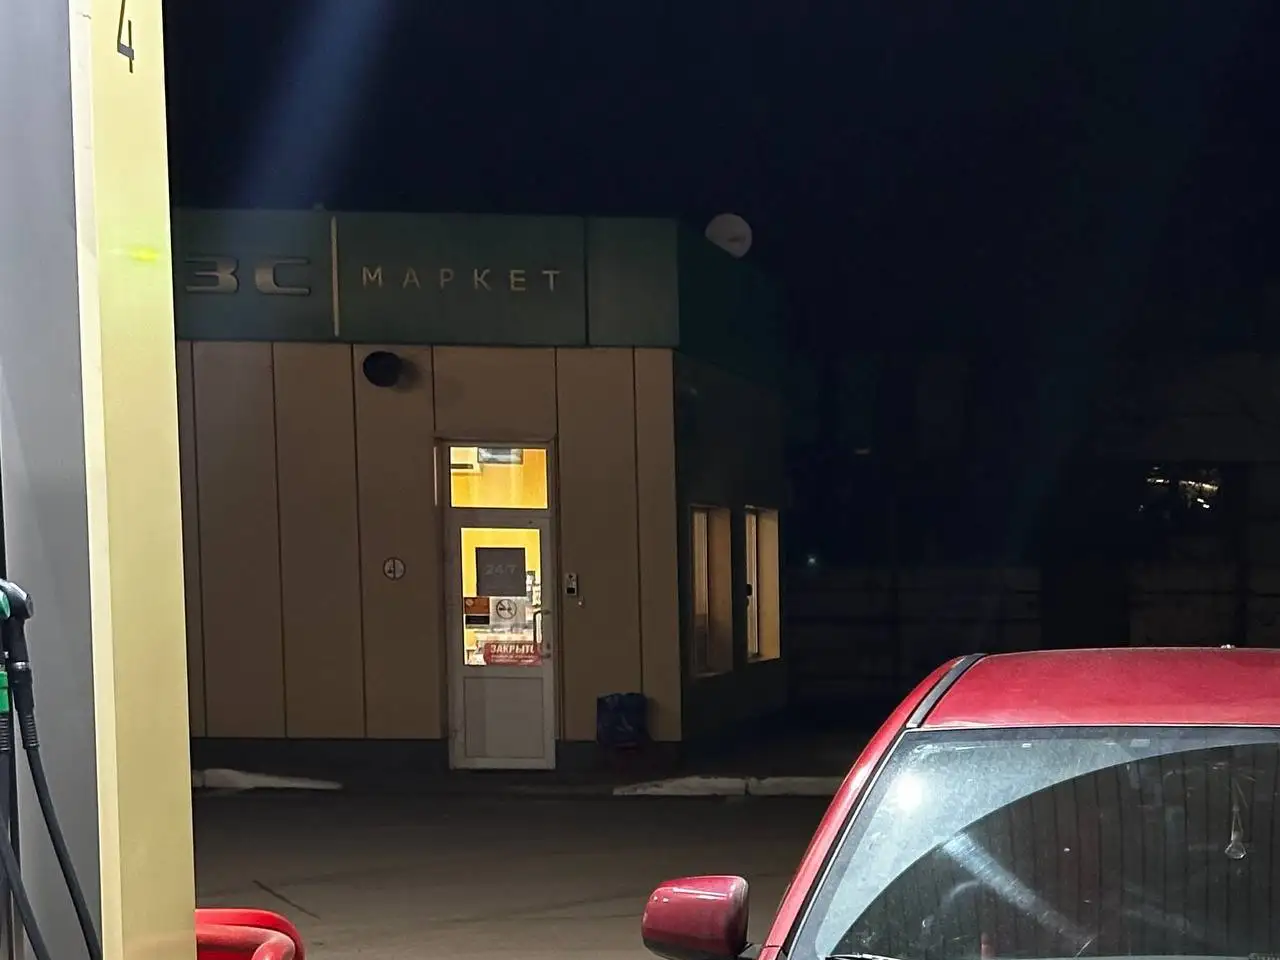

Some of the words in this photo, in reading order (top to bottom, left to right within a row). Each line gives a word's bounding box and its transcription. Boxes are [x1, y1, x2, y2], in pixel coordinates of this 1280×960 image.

[117, 0, 135, 74] 4
[185, 254, 311, 296] ЗС
[361, 265, 562, 292] МАРКЕТ
